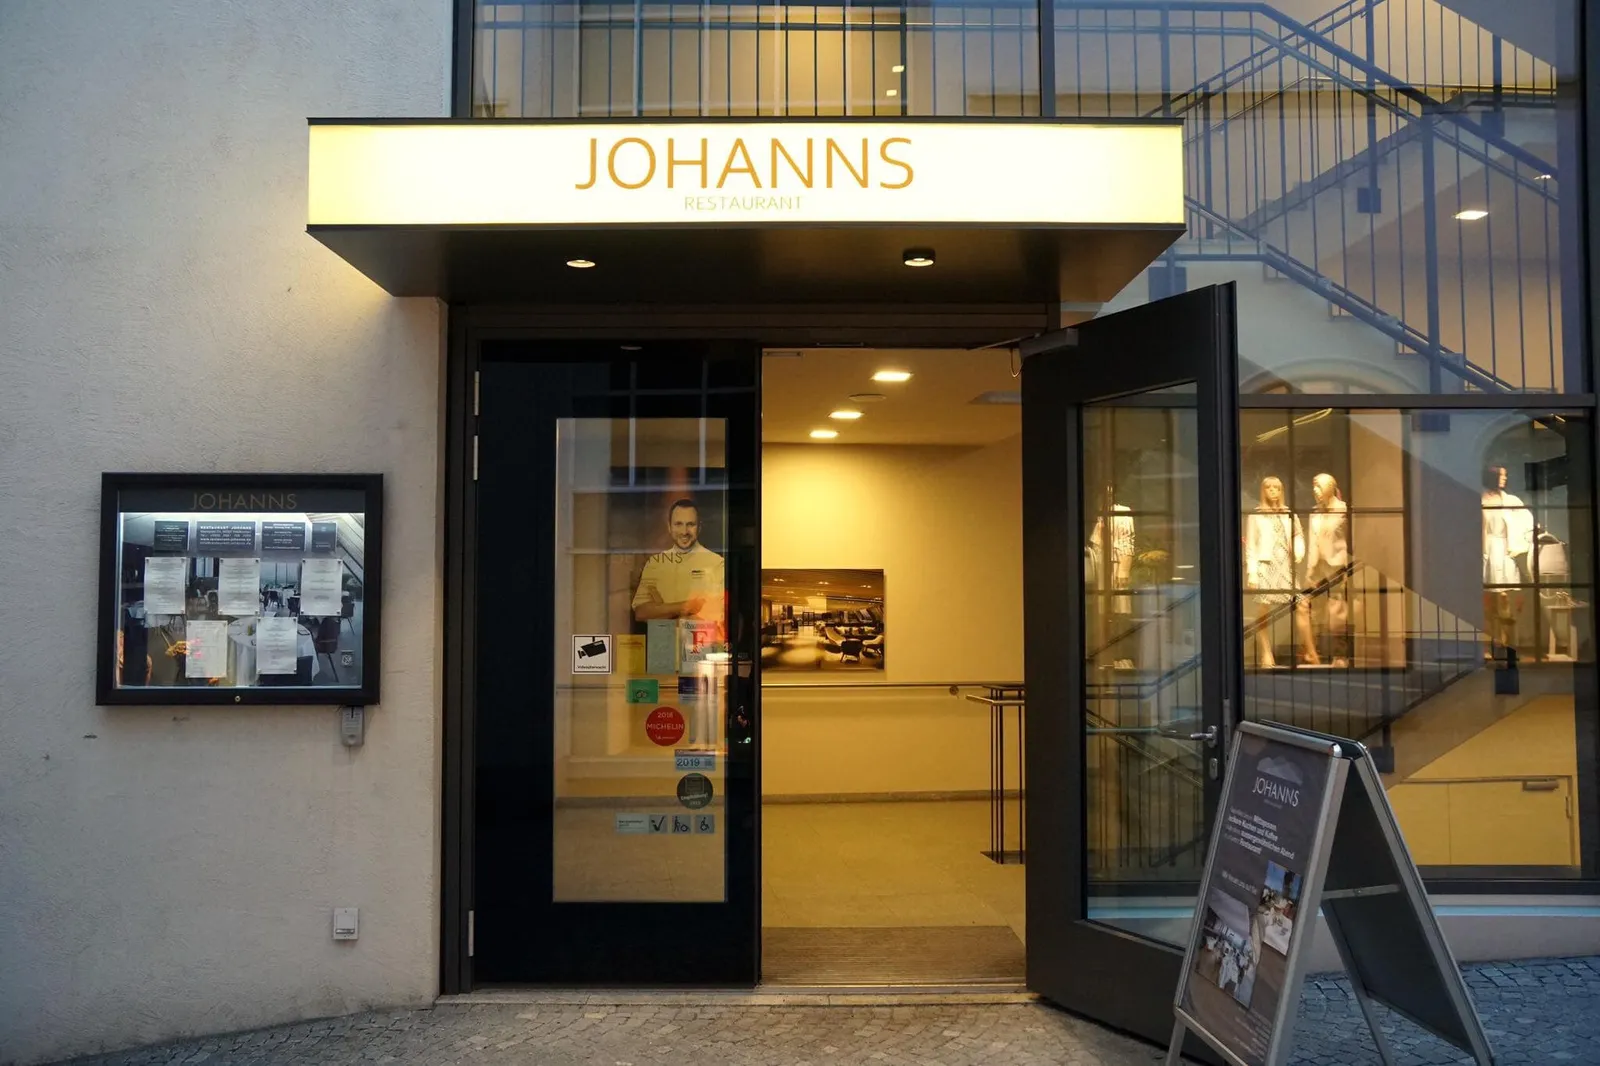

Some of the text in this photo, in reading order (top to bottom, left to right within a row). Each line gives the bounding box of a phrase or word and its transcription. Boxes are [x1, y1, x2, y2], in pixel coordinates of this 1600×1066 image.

[575, 137, 914, 190] JOHANNS
[684, 196, 802, 211] RESTAURANT
[190, 493, 297, 510] JOHANNS
[646, 723, 684, 731] MICHELIN
[676, 758, 700, 767] 2019
[1252, 777, 1300, 807] JOHANNS
